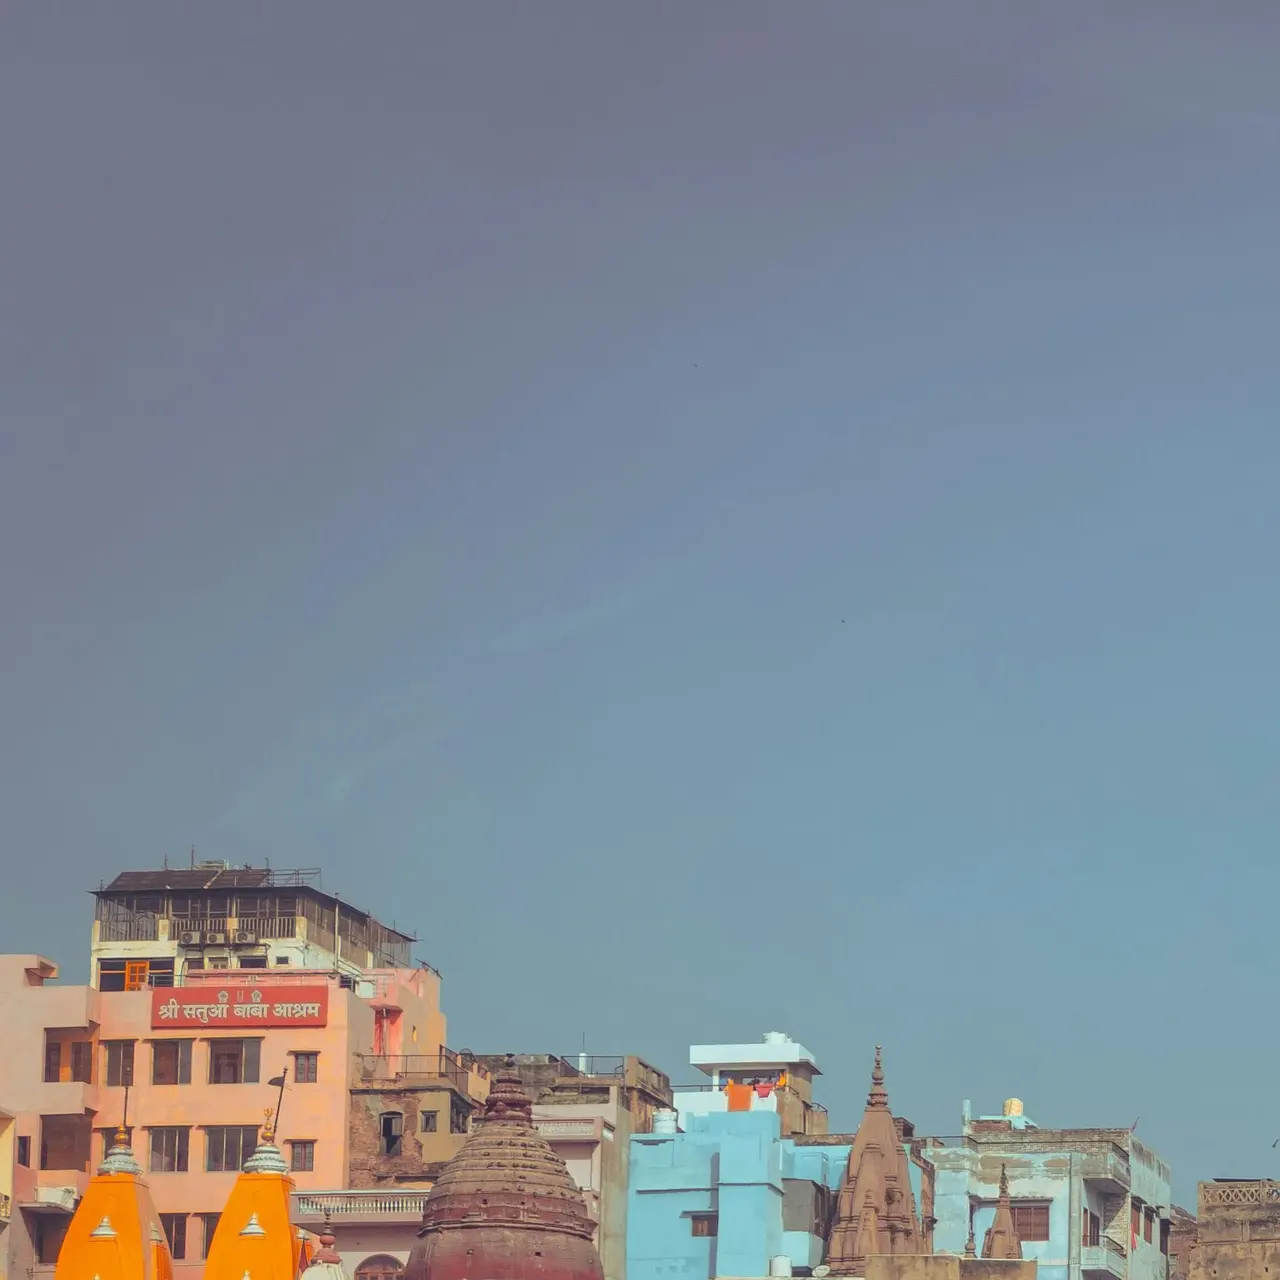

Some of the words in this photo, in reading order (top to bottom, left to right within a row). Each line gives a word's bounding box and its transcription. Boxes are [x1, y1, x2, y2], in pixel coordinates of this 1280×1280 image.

[158, 998, 180, 1019] श्री
[233, 1003, 270, 1018] बाबा
[272, 1003, 321, 1018] आश्रम
